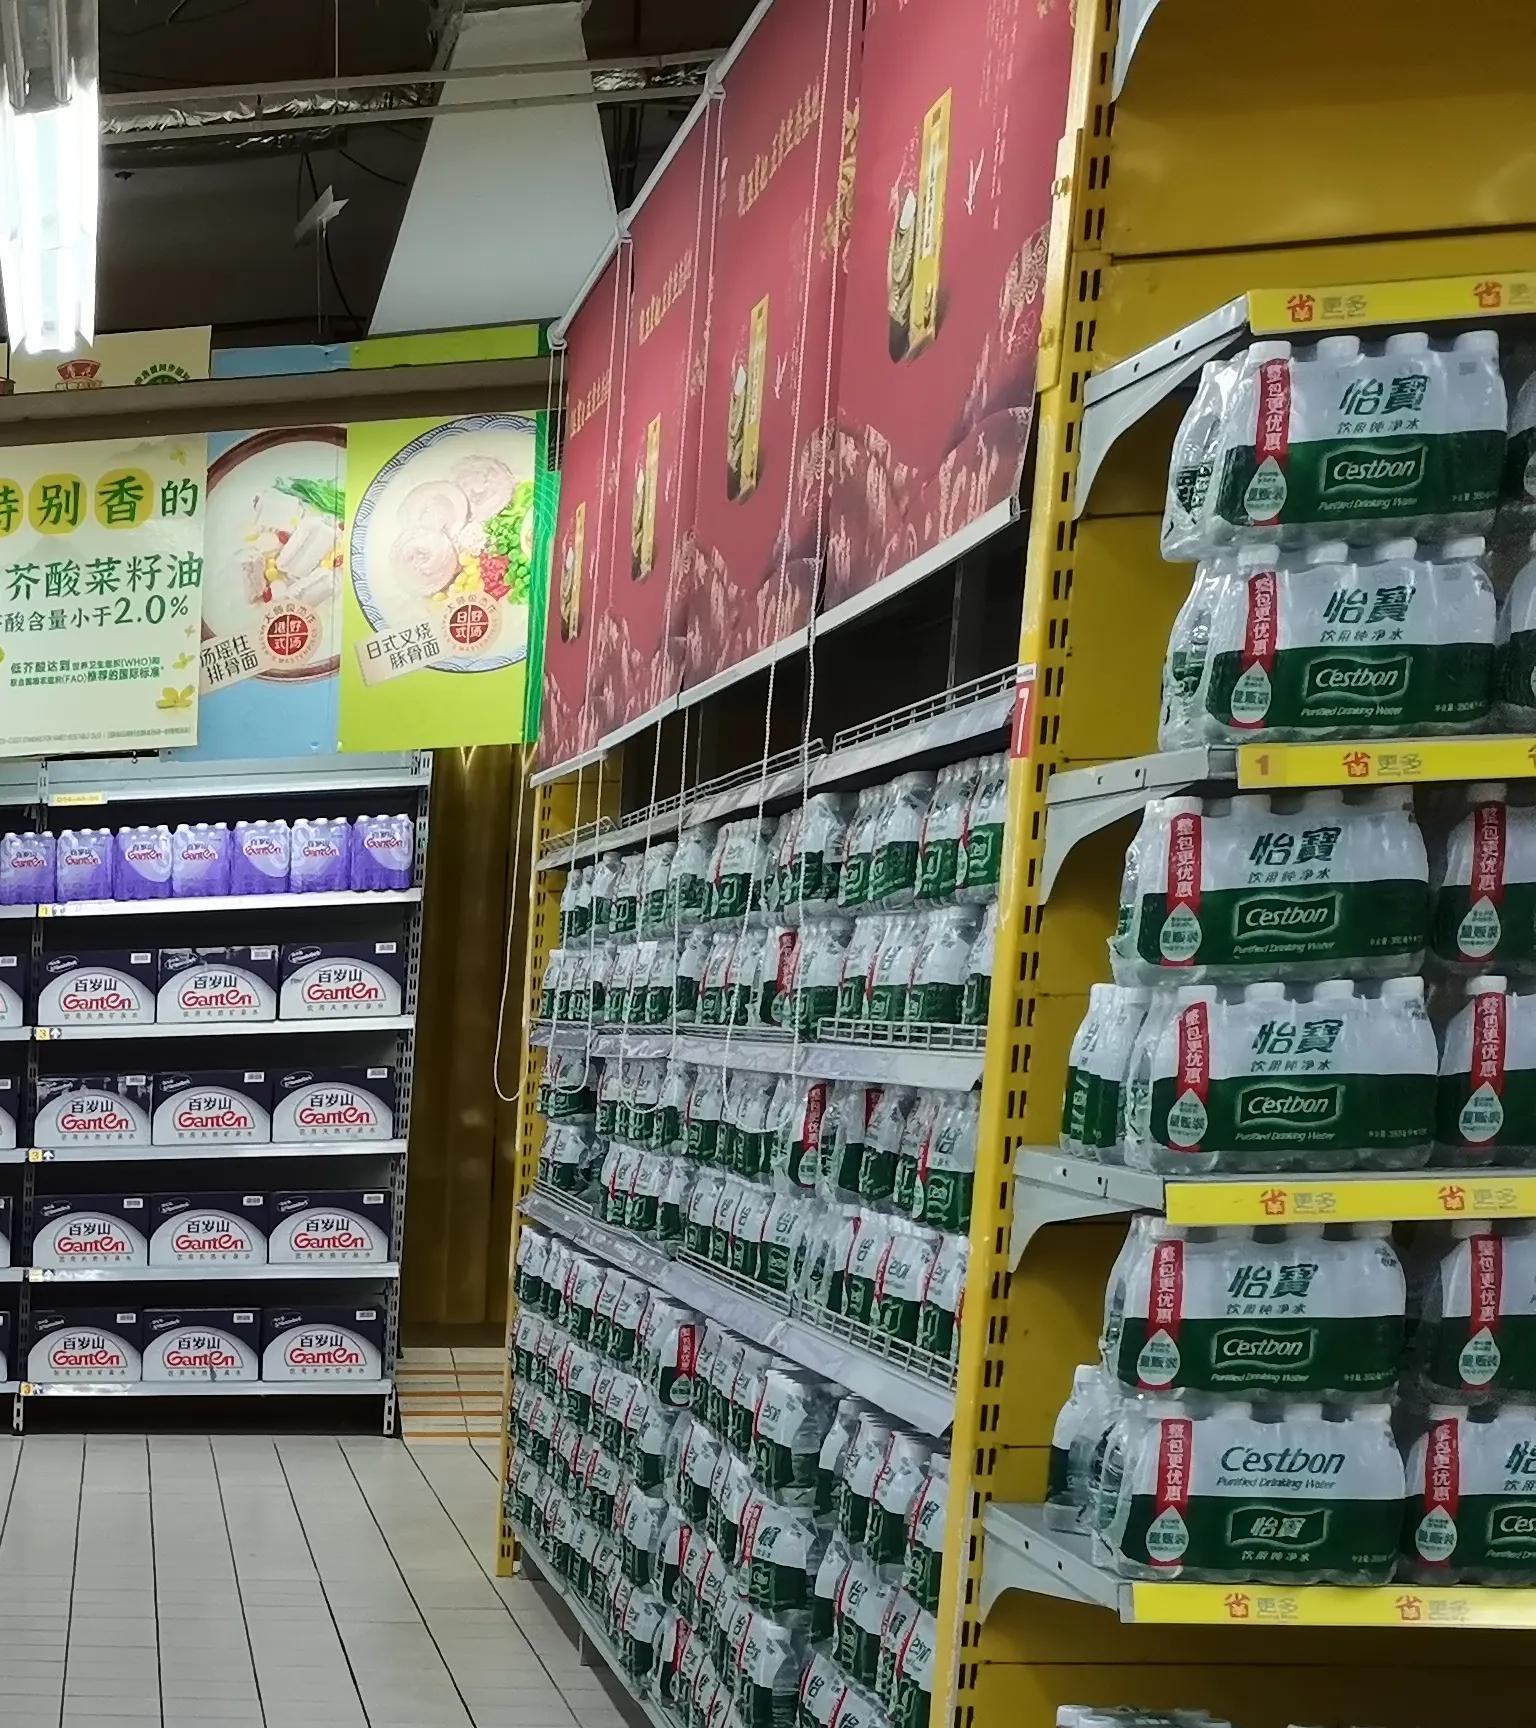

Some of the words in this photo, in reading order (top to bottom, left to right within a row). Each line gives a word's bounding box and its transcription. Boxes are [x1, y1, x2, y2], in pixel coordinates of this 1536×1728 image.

[1264, 364, 1283, 452] 整包更优惠
[1337, 374, 1431, 416] 怡寶
[1252, 576, 1273, 656] 整包更优惠
[1323, 585, 1415, 624] 怡寶
[366, 622, 433, 660] 日式叉烧
[390, 638, 440, 671] 豚骨面
[207, 652, 259, 685] 排骨面
[1175, 817, 1194, 898] 整包更优惠
[1248, 827, 1342, 866] 怡寶
[1480, 807, 1499, 893] 整包更优惠
[75, 978, 117, 992] 百岁山
[194, 975, 237, 989] 百岁山
[307, 983, 379, 1001] Ganten
[319, 968, 362, 983] 百岁山
[63, 993, 132, 1010] Ganten
[181, 989, 253, 1006] Ganten
[1185, 1008, 1203, 1085] 整包更优惠
[1252, 1019, 1343, 1055] 怡寶
[1480, 996, 1499, 1078] 整包更优惠
[1157, 1246, 1176, 1324] 整包更优惠
[1227, 1263, 1318, 1299] 怡寶
[63, 1336, 105, 1350] 百岁山
[289, 1348, 359, 1365] Ganten
[300, 1334, 344, 1348] 百岁山
[52, 1350, 121, 1367] Ganten
[1164, 1424, 1184, 1502] 整包更优惠
[1221, 1446, 1345, 1474] C'estbon
[1250, 1516, 1306, 1538] 怡寶
